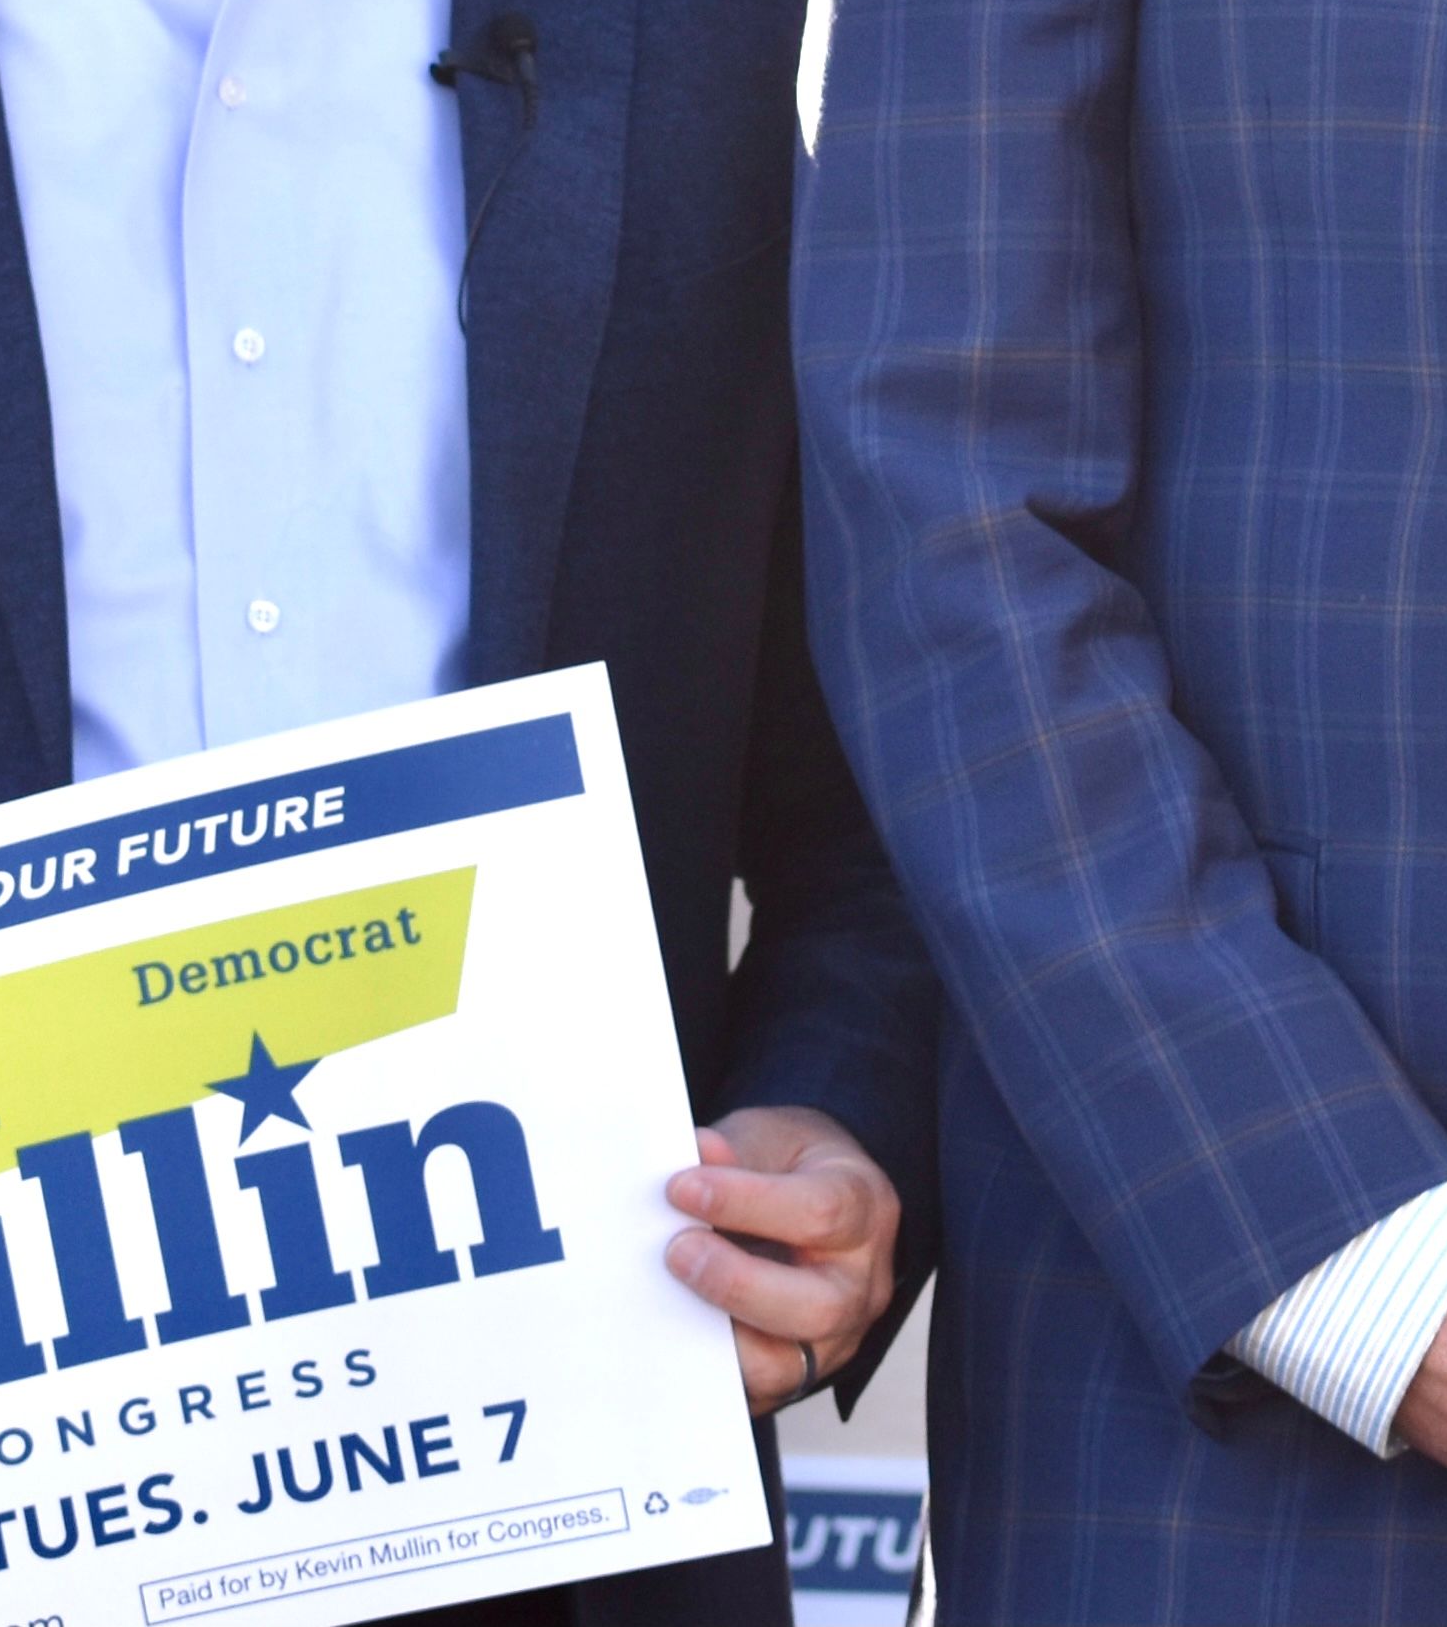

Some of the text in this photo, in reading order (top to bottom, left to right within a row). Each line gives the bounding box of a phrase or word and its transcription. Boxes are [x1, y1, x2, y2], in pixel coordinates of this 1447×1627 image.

[115, 784, 348, 880] FUTURE
[130, 906, 422, 1008] Democrat
[236, 1412, 462, 1518] JUNE
[481, 1398, 530, 1466] 7
[158, 1500, 612, 1611] Paid for by Kevin Mullin for Congress.
